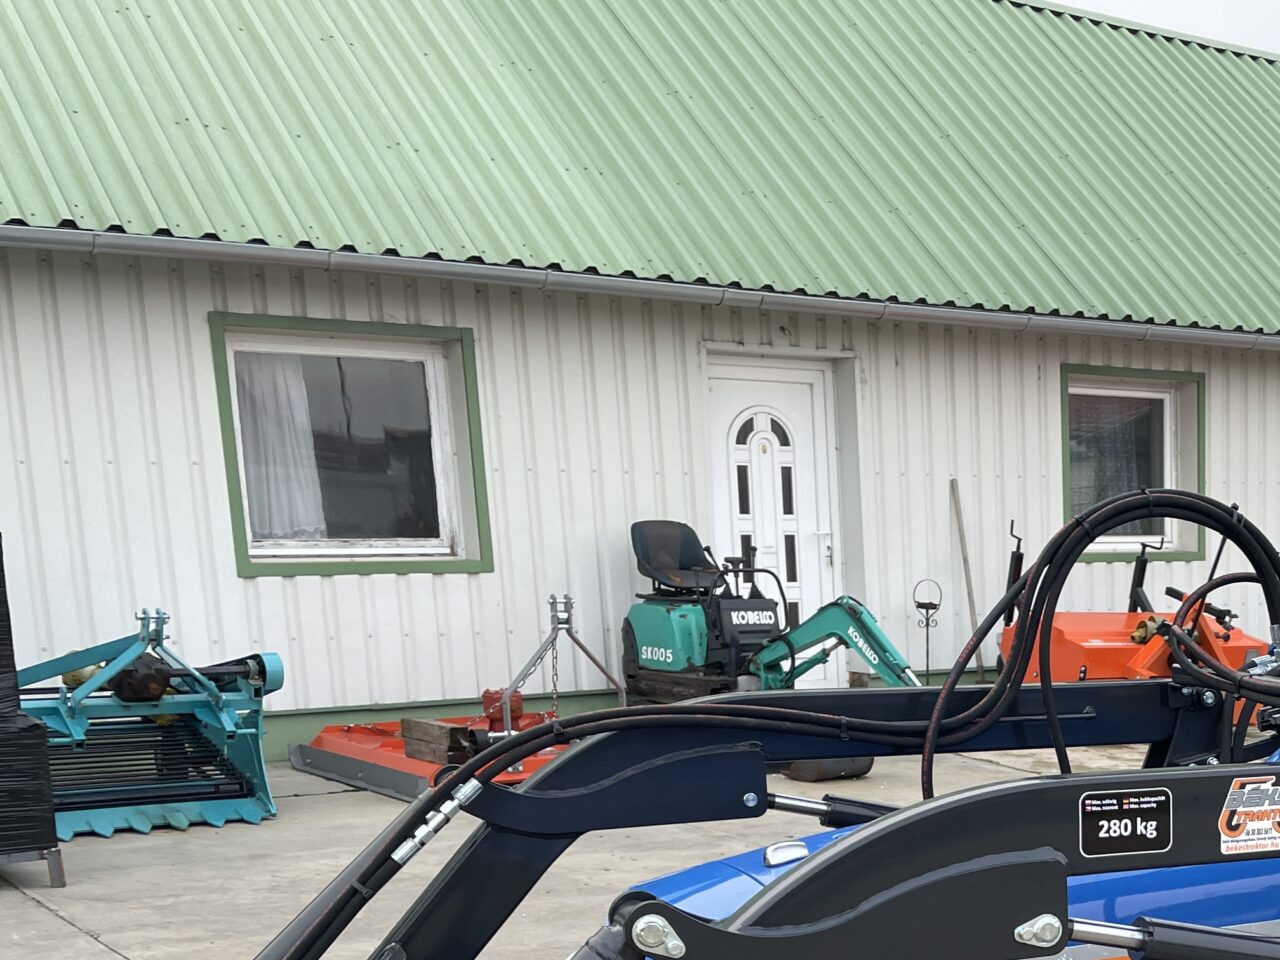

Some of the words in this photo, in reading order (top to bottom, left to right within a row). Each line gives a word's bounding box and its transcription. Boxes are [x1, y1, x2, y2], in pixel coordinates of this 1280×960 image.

[731, 610, 775, 625] KOBELCO
[641, 645, 674, 663] SK005
[847, 625, 879, 665] KOBELCO
[1098, 818, 1132, 838] 280
[1136, 817, 1157, 838] kg
